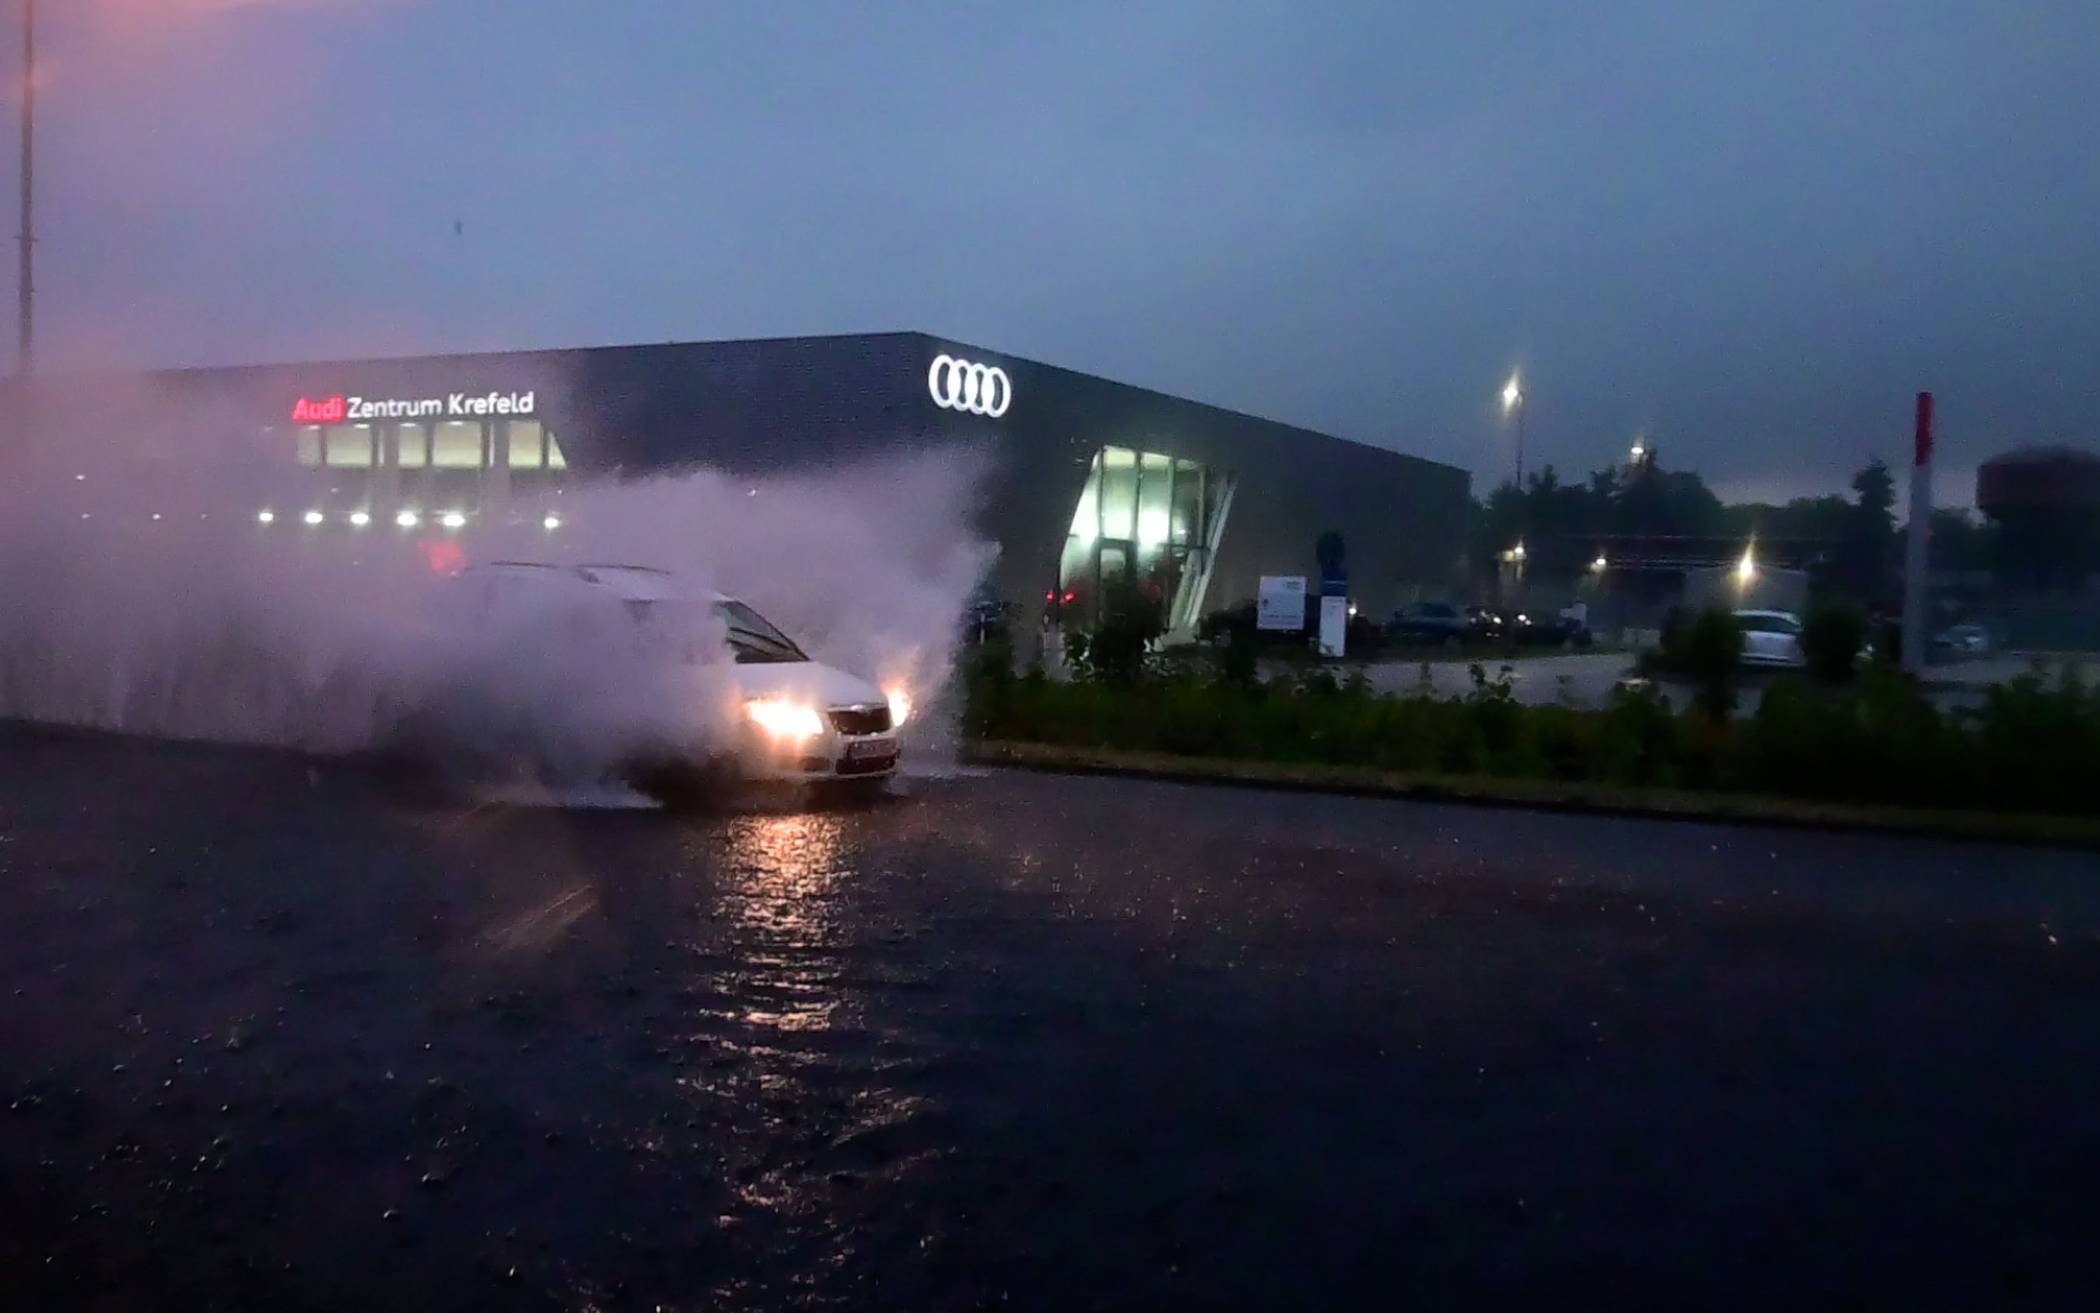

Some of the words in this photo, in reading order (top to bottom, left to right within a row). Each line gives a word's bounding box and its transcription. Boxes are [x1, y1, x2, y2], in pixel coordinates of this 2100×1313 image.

[294, 397, 343, 421] Audi
[347, 396, 441, 418] Zentrum
[448, 391, 534, 415] Krefeld
